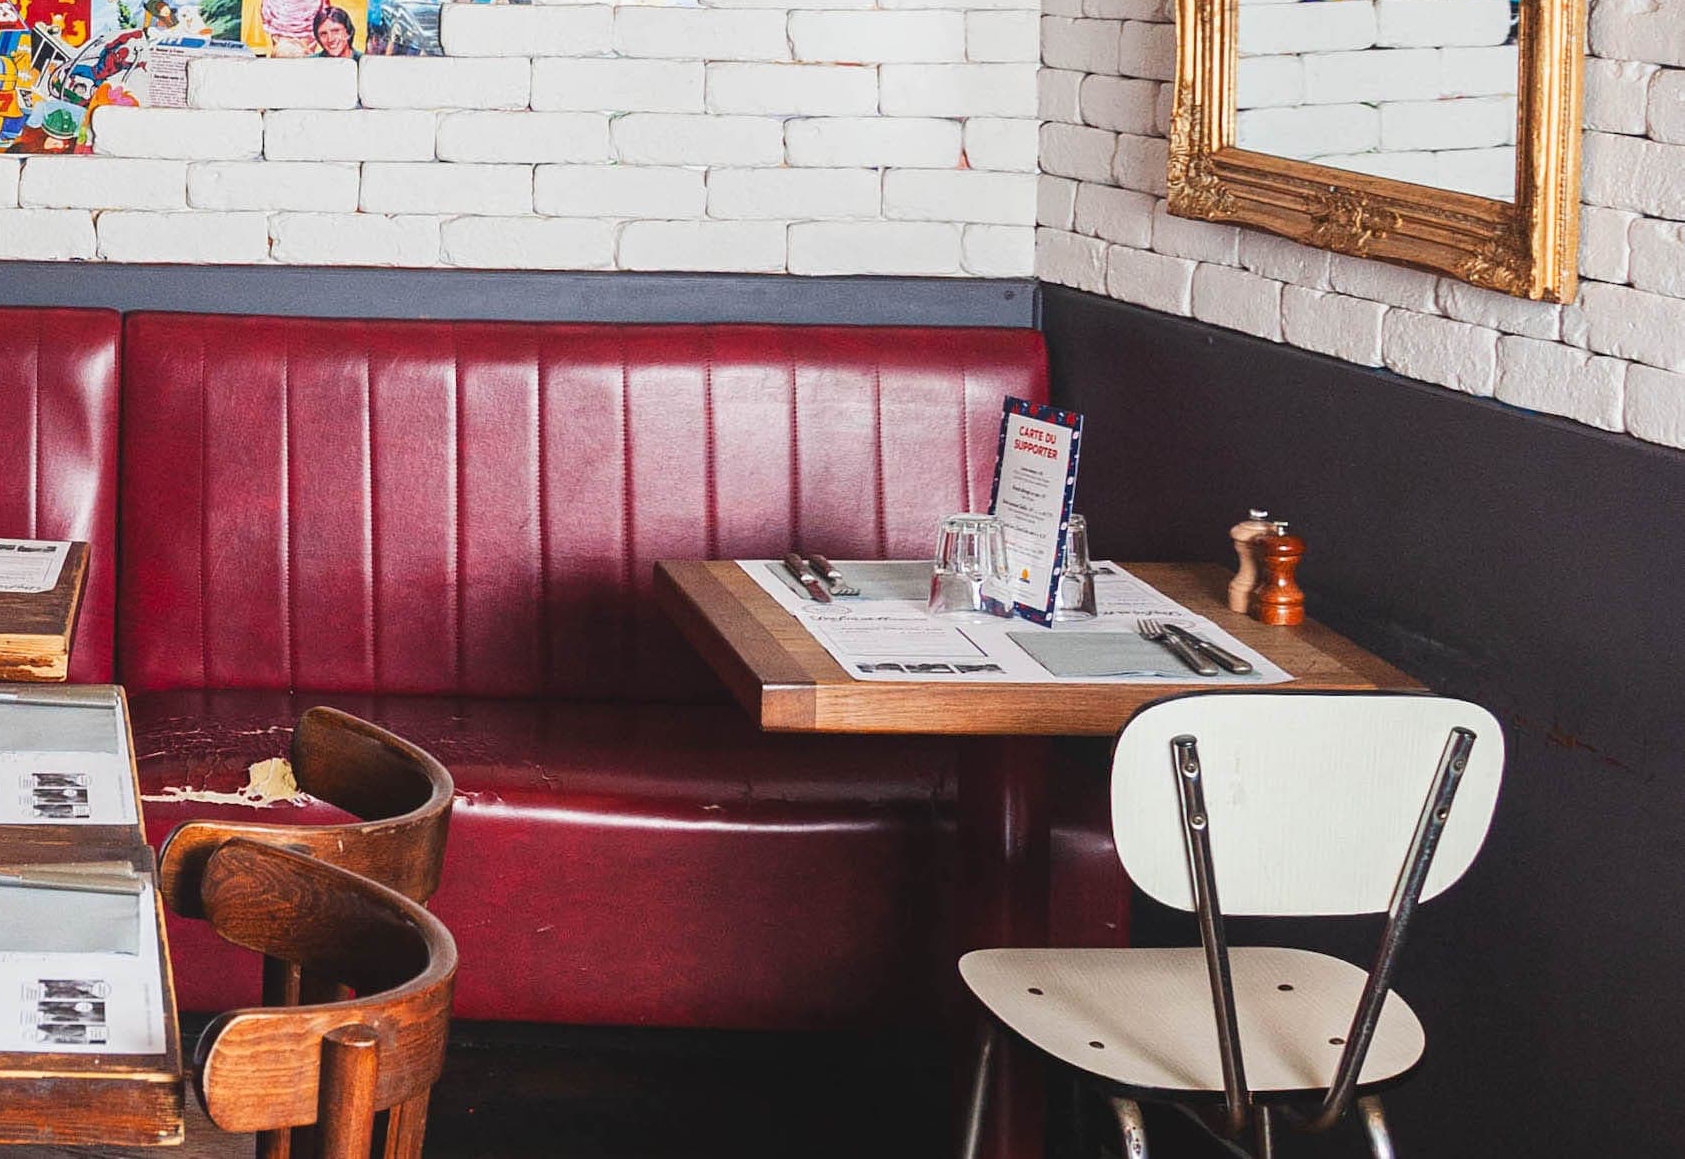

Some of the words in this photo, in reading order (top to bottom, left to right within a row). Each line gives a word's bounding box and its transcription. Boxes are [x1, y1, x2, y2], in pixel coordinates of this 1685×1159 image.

[1018, 425, 1044, 442] CARTE
[1045, 431, 1057, 445] DU
[1013, 438, 1059, 462] SUPPORTER
